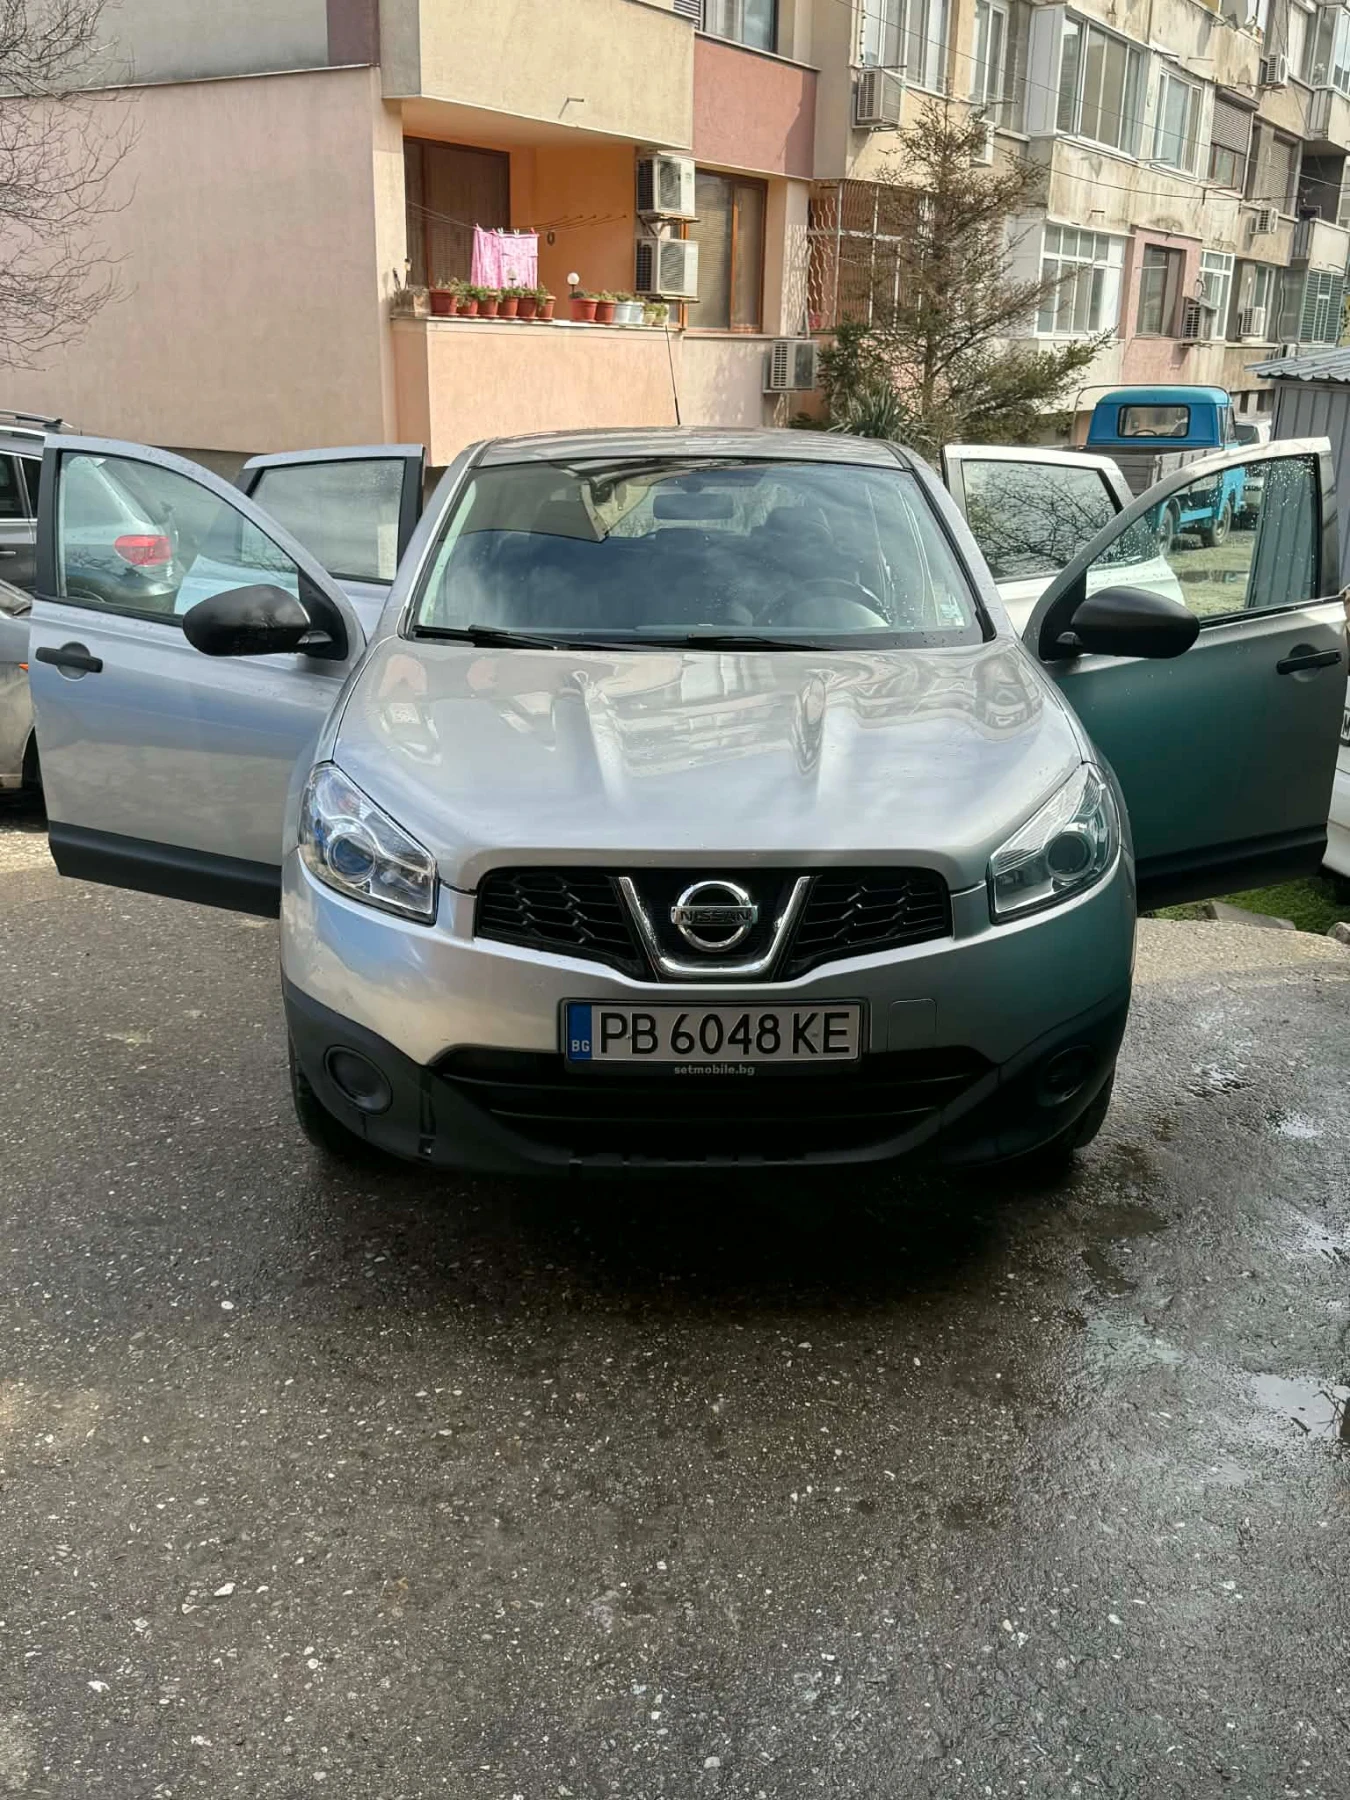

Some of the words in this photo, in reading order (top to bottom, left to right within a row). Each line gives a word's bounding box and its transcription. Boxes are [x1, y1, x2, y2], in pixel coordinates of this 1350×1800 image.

[679, 910, 751, 922] NISSAN
[600, 1012, 658, 1054] PB
[670, 1013, 781, 1055] 6048
[792, 1012, 850, 1054] KE
[571, 1040, 590, 1052] BG
[674, 1064, 755, 1076] setmobile.bg
